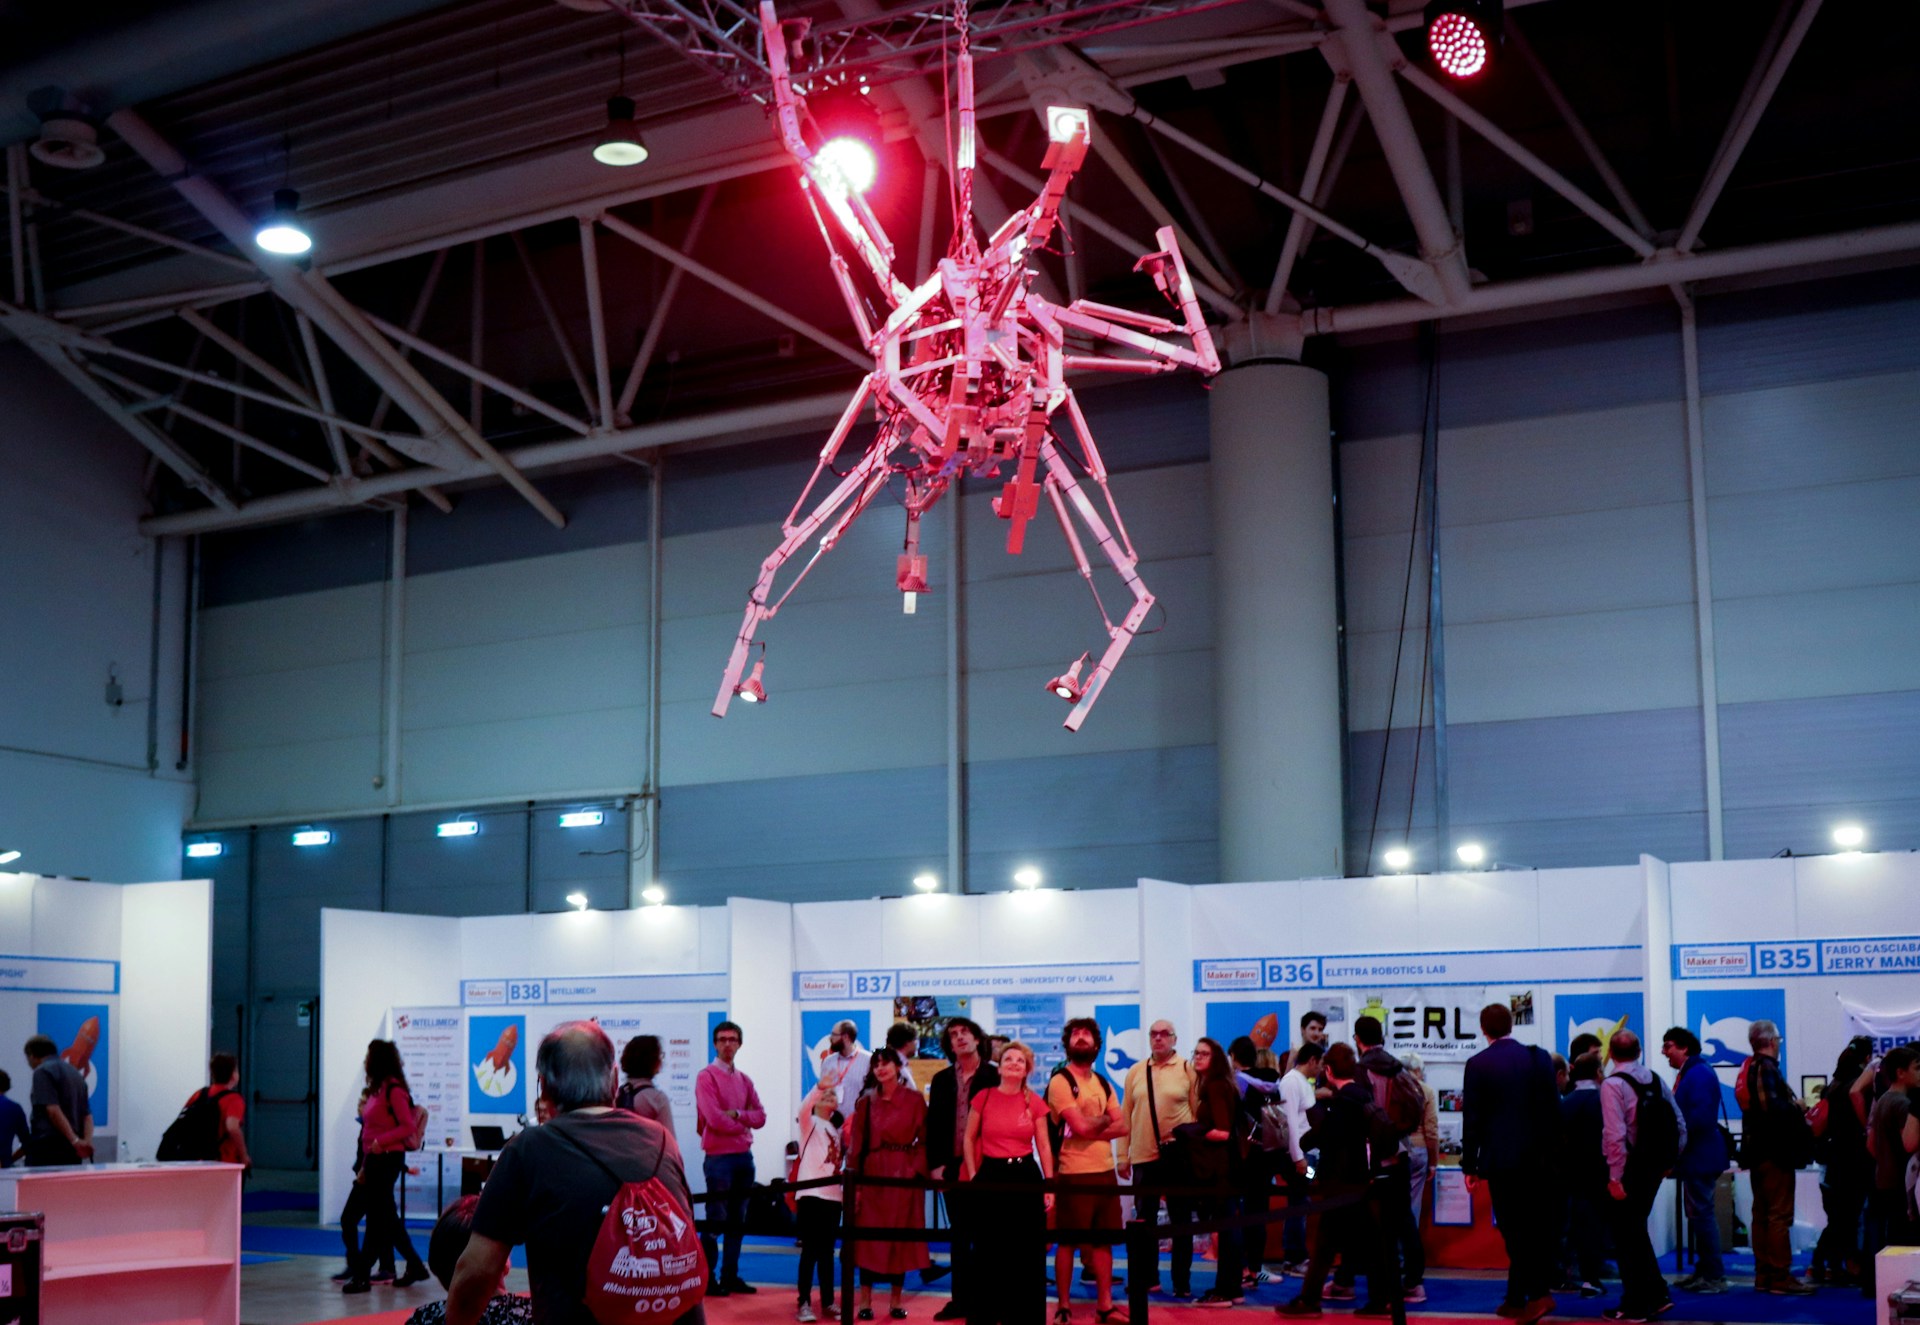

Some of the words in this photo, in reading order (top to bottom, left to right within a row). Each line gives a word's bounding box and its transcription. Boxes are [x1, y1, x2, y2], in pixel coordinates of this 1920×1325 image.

[1826, 945, 1861, 954] FABIO
[1687, 957, 1716, 966] Maker
[1720, 956, 1744, 965] Faire
[1760, 949, 1811, 969] B35
[1827, 957, 1875, 969] JERRY
[1880, 955, 1920, 967] MAN
[1207, 971, 1233, 979] Maker
[1235, 970, 1256, 978] Faire
[1269, 964, 1313, 983] B36
[1325, 967, 1369, 976] ELETTRA
[1371, 966, 1423, 975] ROBOTICS
[1426, 965, 1446, 974] LAB
[804, 982, 826, 990] Maker
[828, 981, 845, 989] Faire
[856, 975, 892, 993] B37
[902, 979, 930, 987] CENTER
[943, 976, 990, 985] EXCELLENCE
[992, 975, 1014, 984] DEWS
[1020, 973, 1064, 984] UNIVERSITY
[1067, 974, 1077, 982] OF
[1078, 973, 1114, 983] L'AQUILA
[510, 984, 541, 1000] B38
[550, 987, 596, 995] INTELLIMECH
[412, 1018, 458, 1026] INTELLIMECH
[601, 1019, 640, 1027] INTELLIMECH
[1393, 1007, 1477, 1039] ERL
